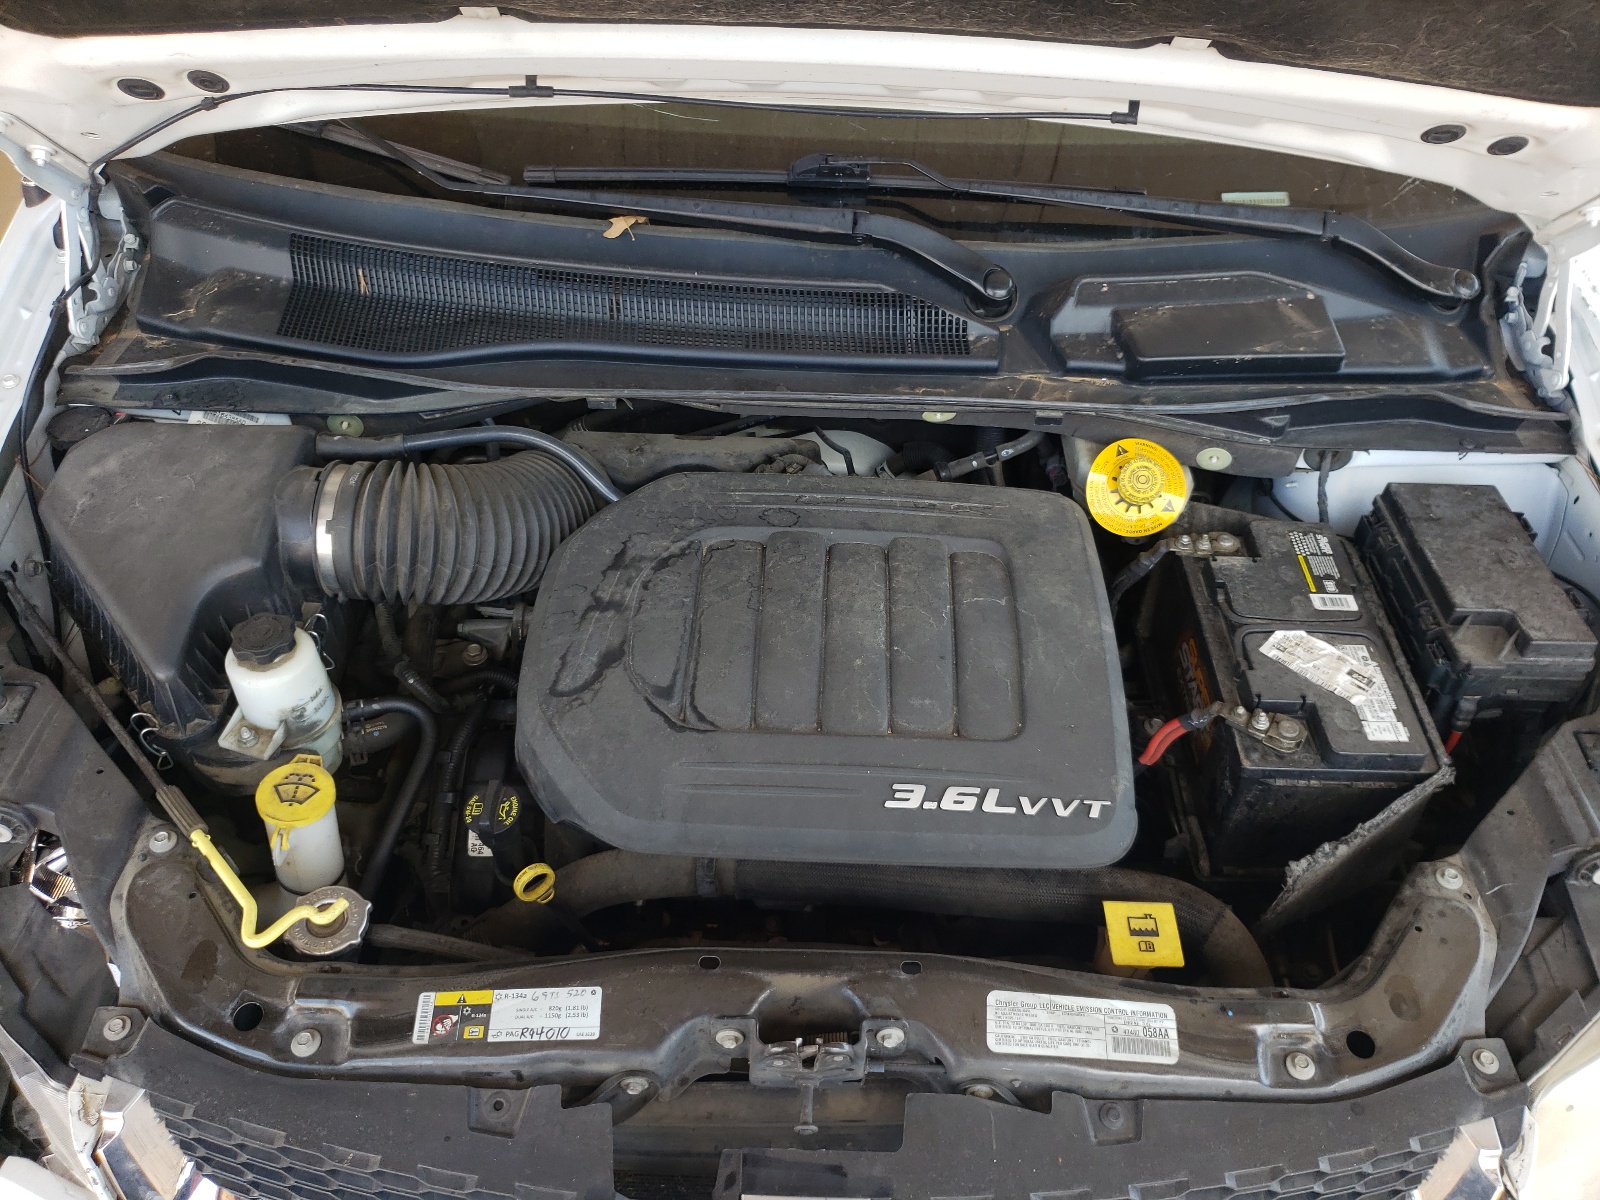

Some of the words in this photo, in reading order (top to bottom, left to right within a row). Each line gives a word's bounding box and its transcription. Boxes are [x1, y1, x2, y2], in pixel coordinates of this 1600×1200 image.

[884, 783, 1017, 814] 3.6L
[1019, 796, 1111, 818] VVT
[504, 816, 514, 825] OIL
[995, 999, 1018, 1007] Chrysler
[1021, 1001, 1037, 1009] Group
[1051, 1003, 1074, 1011] VEHICLE
[1076, 1005, 1102, 1014] EMISSION
[1104, 1008, 1129, 1016] CONTROL
[1130, 1010, 1168, 1019] INFORMATION
[1143, 1026, 1169, 1039] 058AA
